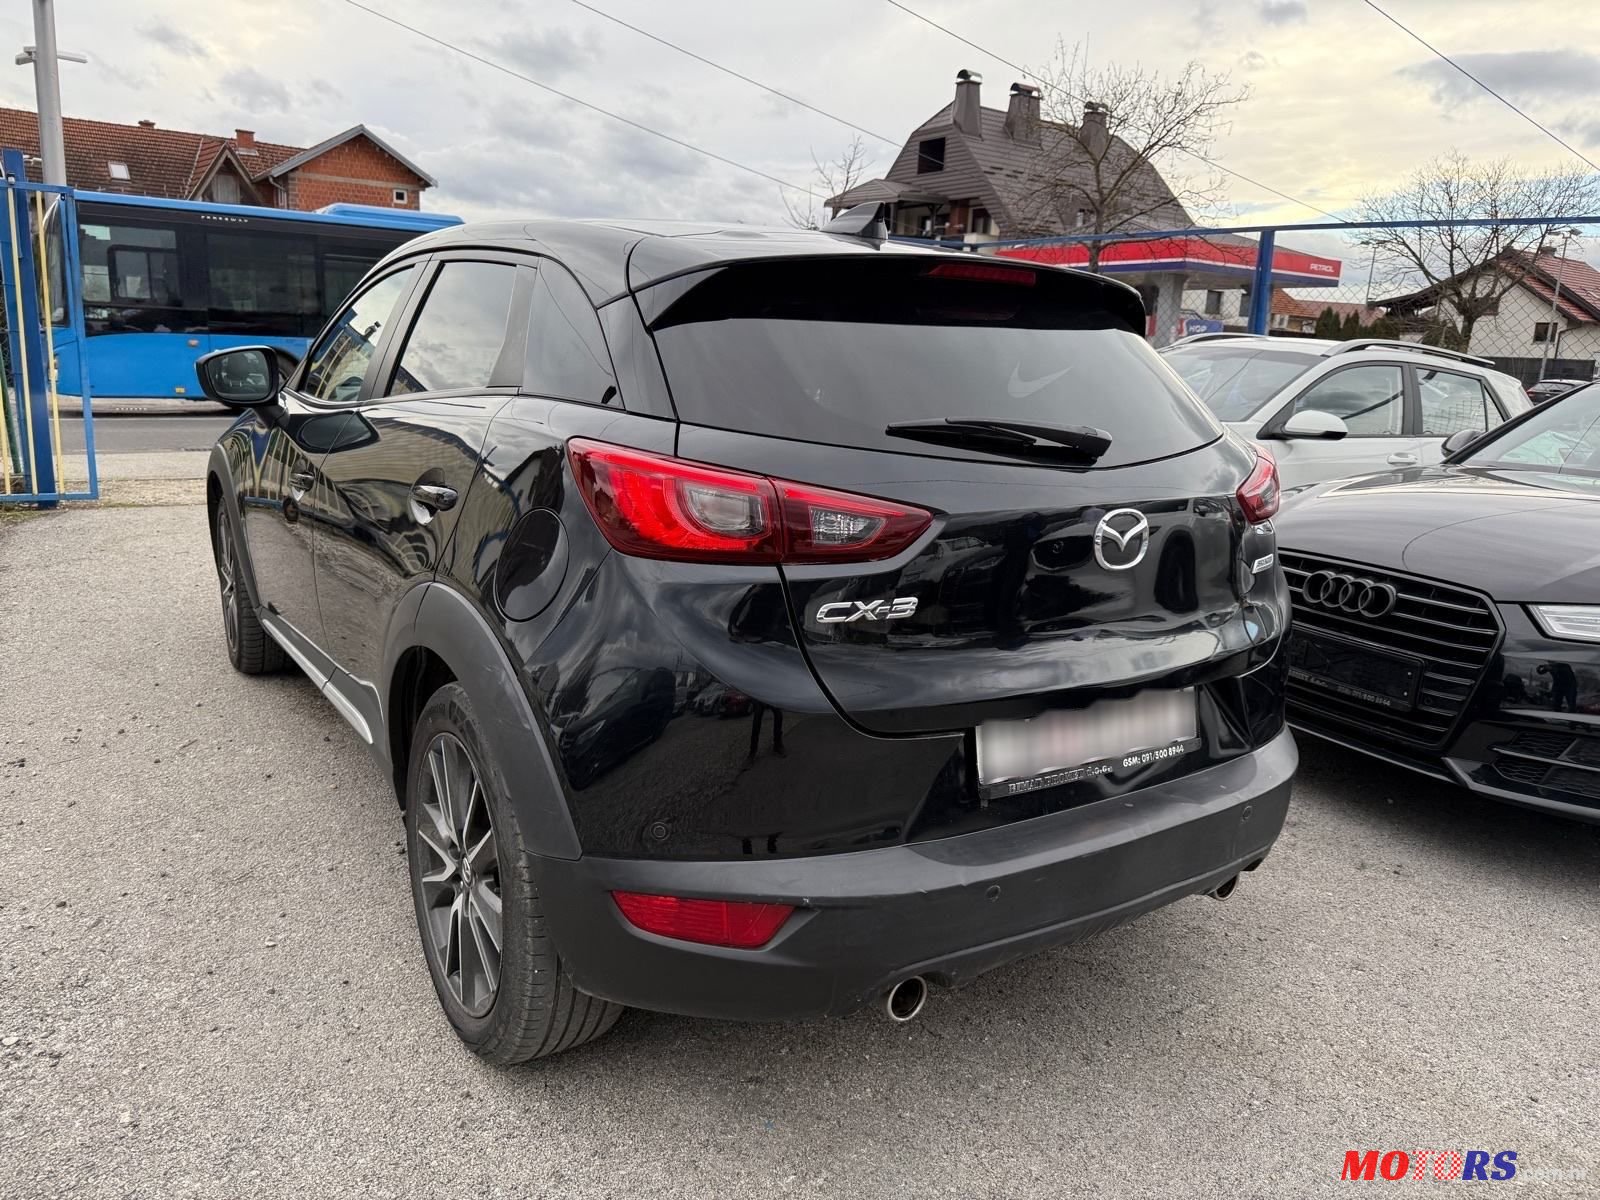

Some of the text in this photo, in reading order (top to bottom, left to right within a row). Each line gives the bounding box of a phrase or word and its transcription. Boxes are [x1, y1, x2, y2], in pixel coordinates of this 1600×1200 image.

[1310, 263, 1335, 273] PETROL
[816, 596, 919, 623] CX-3
[1123, 756, 1140, 767] GSM:
[1142, 748, 1168, 763] 091/500
[1168, 744, 1184, 757] 8944
